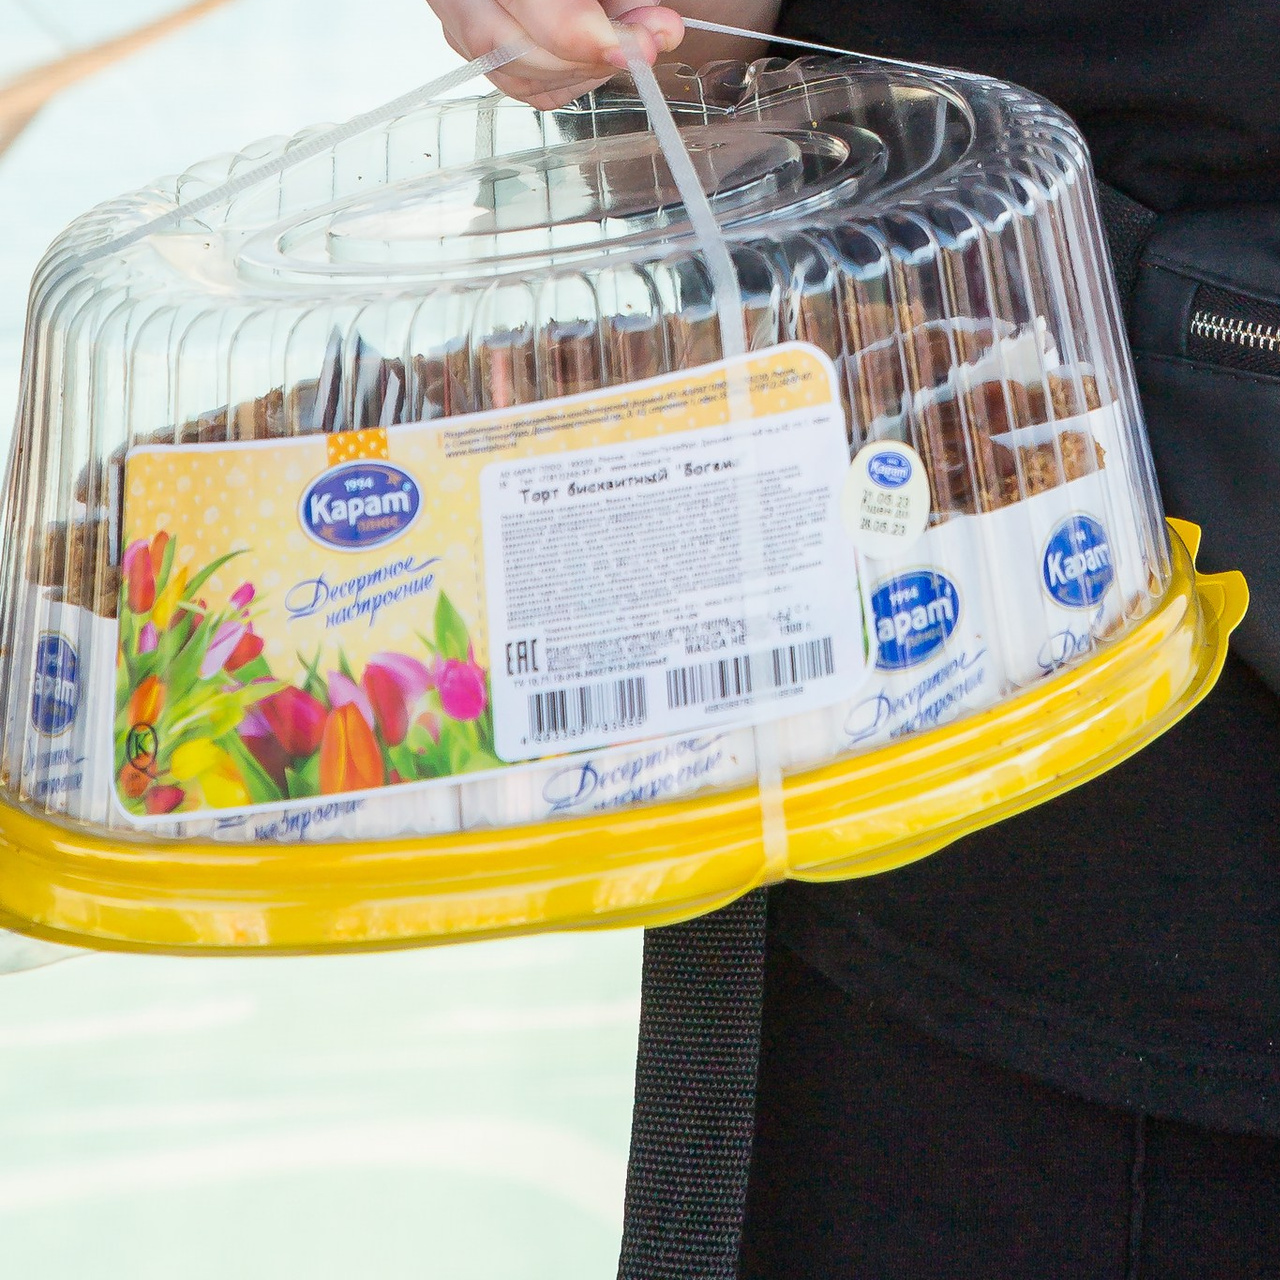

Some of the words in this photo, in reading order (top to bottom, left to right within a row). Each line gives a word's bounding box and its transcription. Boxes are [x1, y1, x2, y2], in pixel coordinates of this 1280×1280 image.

[344, 475, 375, 492] 1994
[518, 485, 560, 507] Торт
[567, 465, 669, 498] бисквитный
[310, 489, 411, 527] Карат
[285, 555, 442, 624] Десертное
[325, 573, 435, 628] настроение
[875, 596, 955, 642] арат
